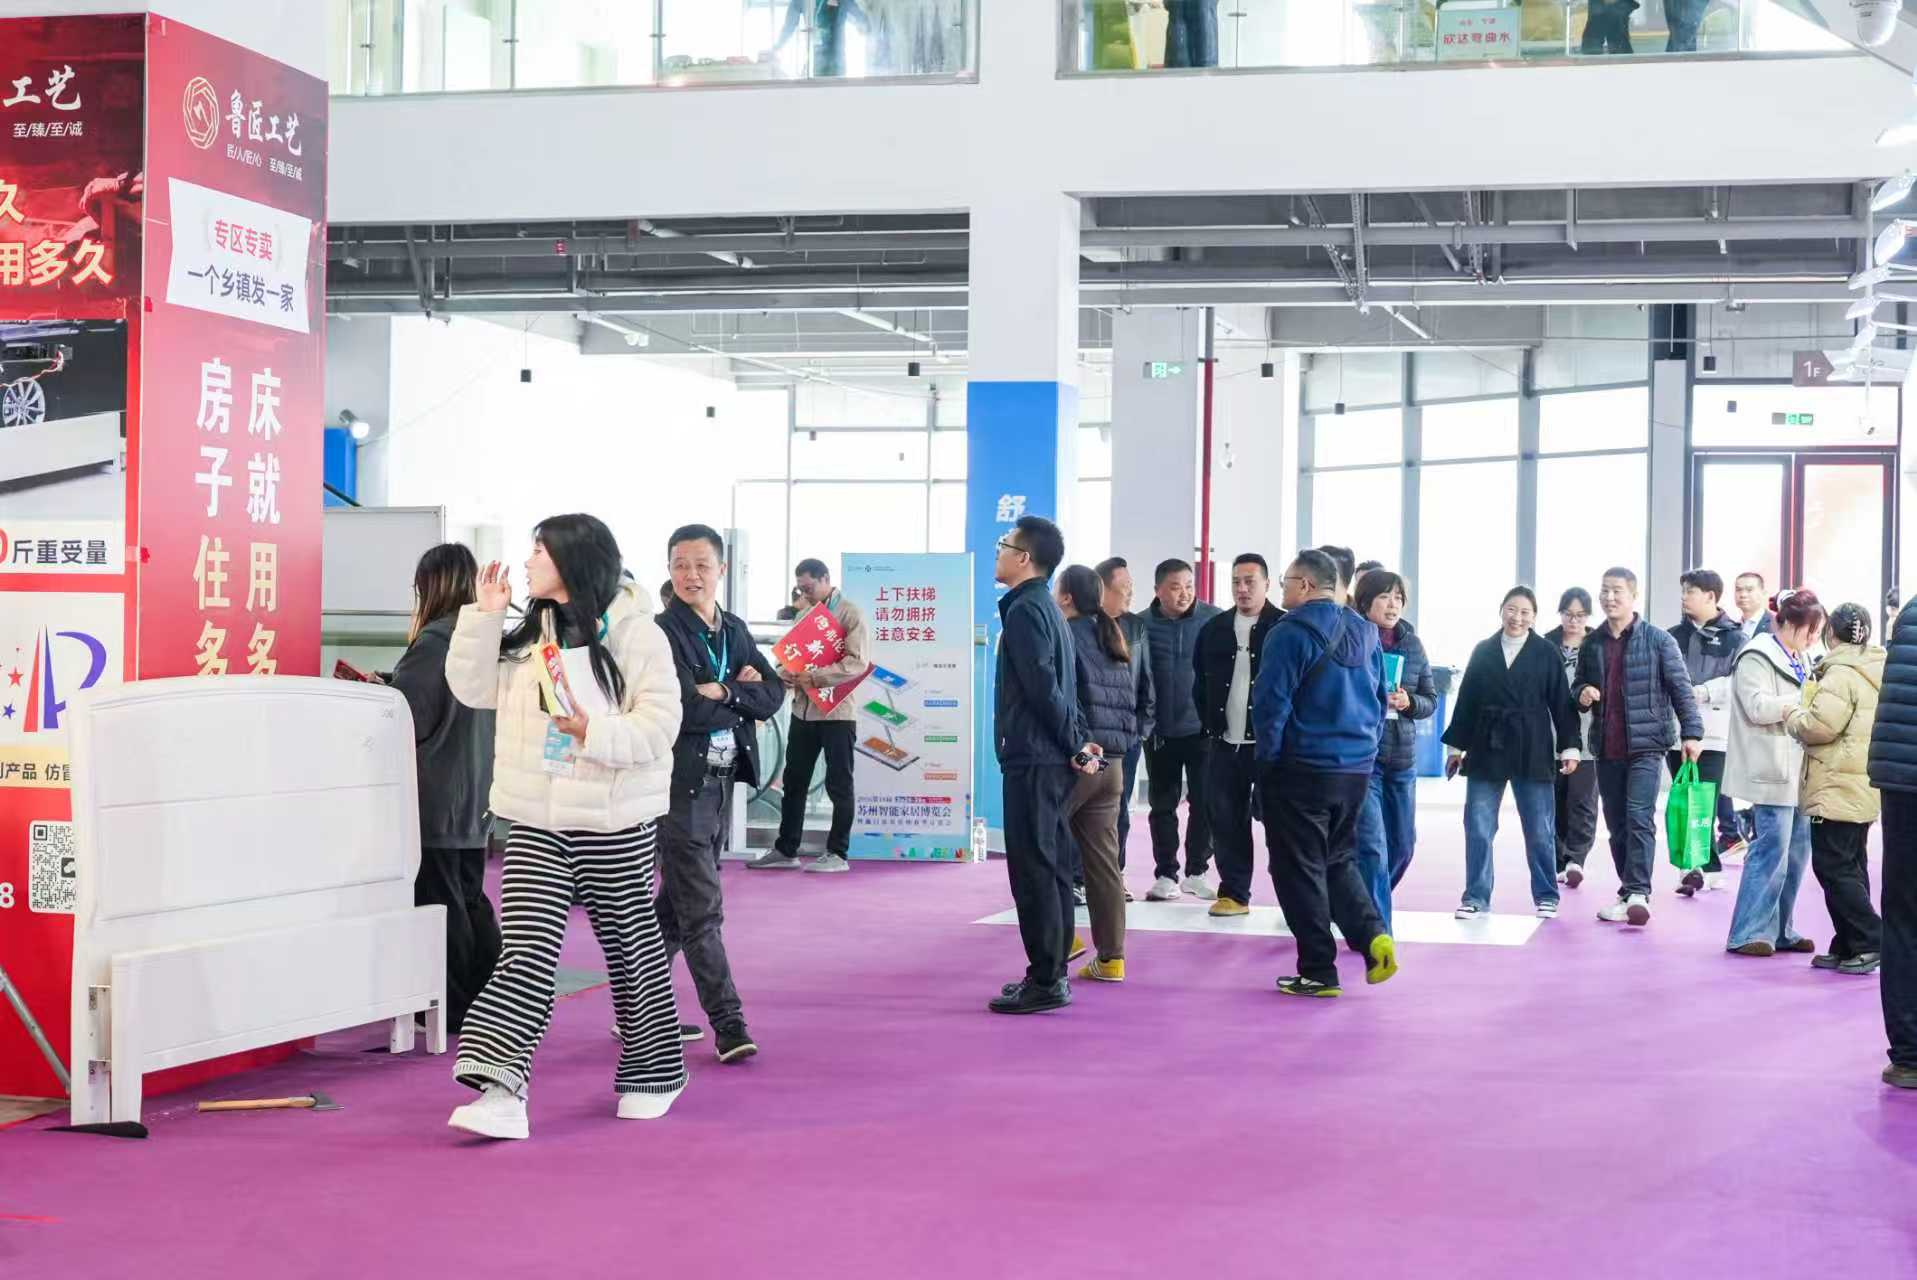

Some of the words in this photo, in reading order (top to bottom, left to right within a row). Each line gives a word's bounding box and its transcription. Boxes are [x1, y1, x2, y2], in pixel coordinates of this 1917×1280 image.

[2, 65, 81, 110] 工艺
[13, 121, 83, 138] 至/臻/至/诚
[225, 89, 302, 156] 鲁匠工艺
[214, 220, 273, 262] 专区专卖
[187, 264, 294, 313] 一个乡镇发一家
[1802, 360, 1821, 378] 1F
[875, 586, 937, 602] 上下扶梯
[875, 606, 937, 622] 请勿拥挤
[875, 626, 937, 642] 注意安全
